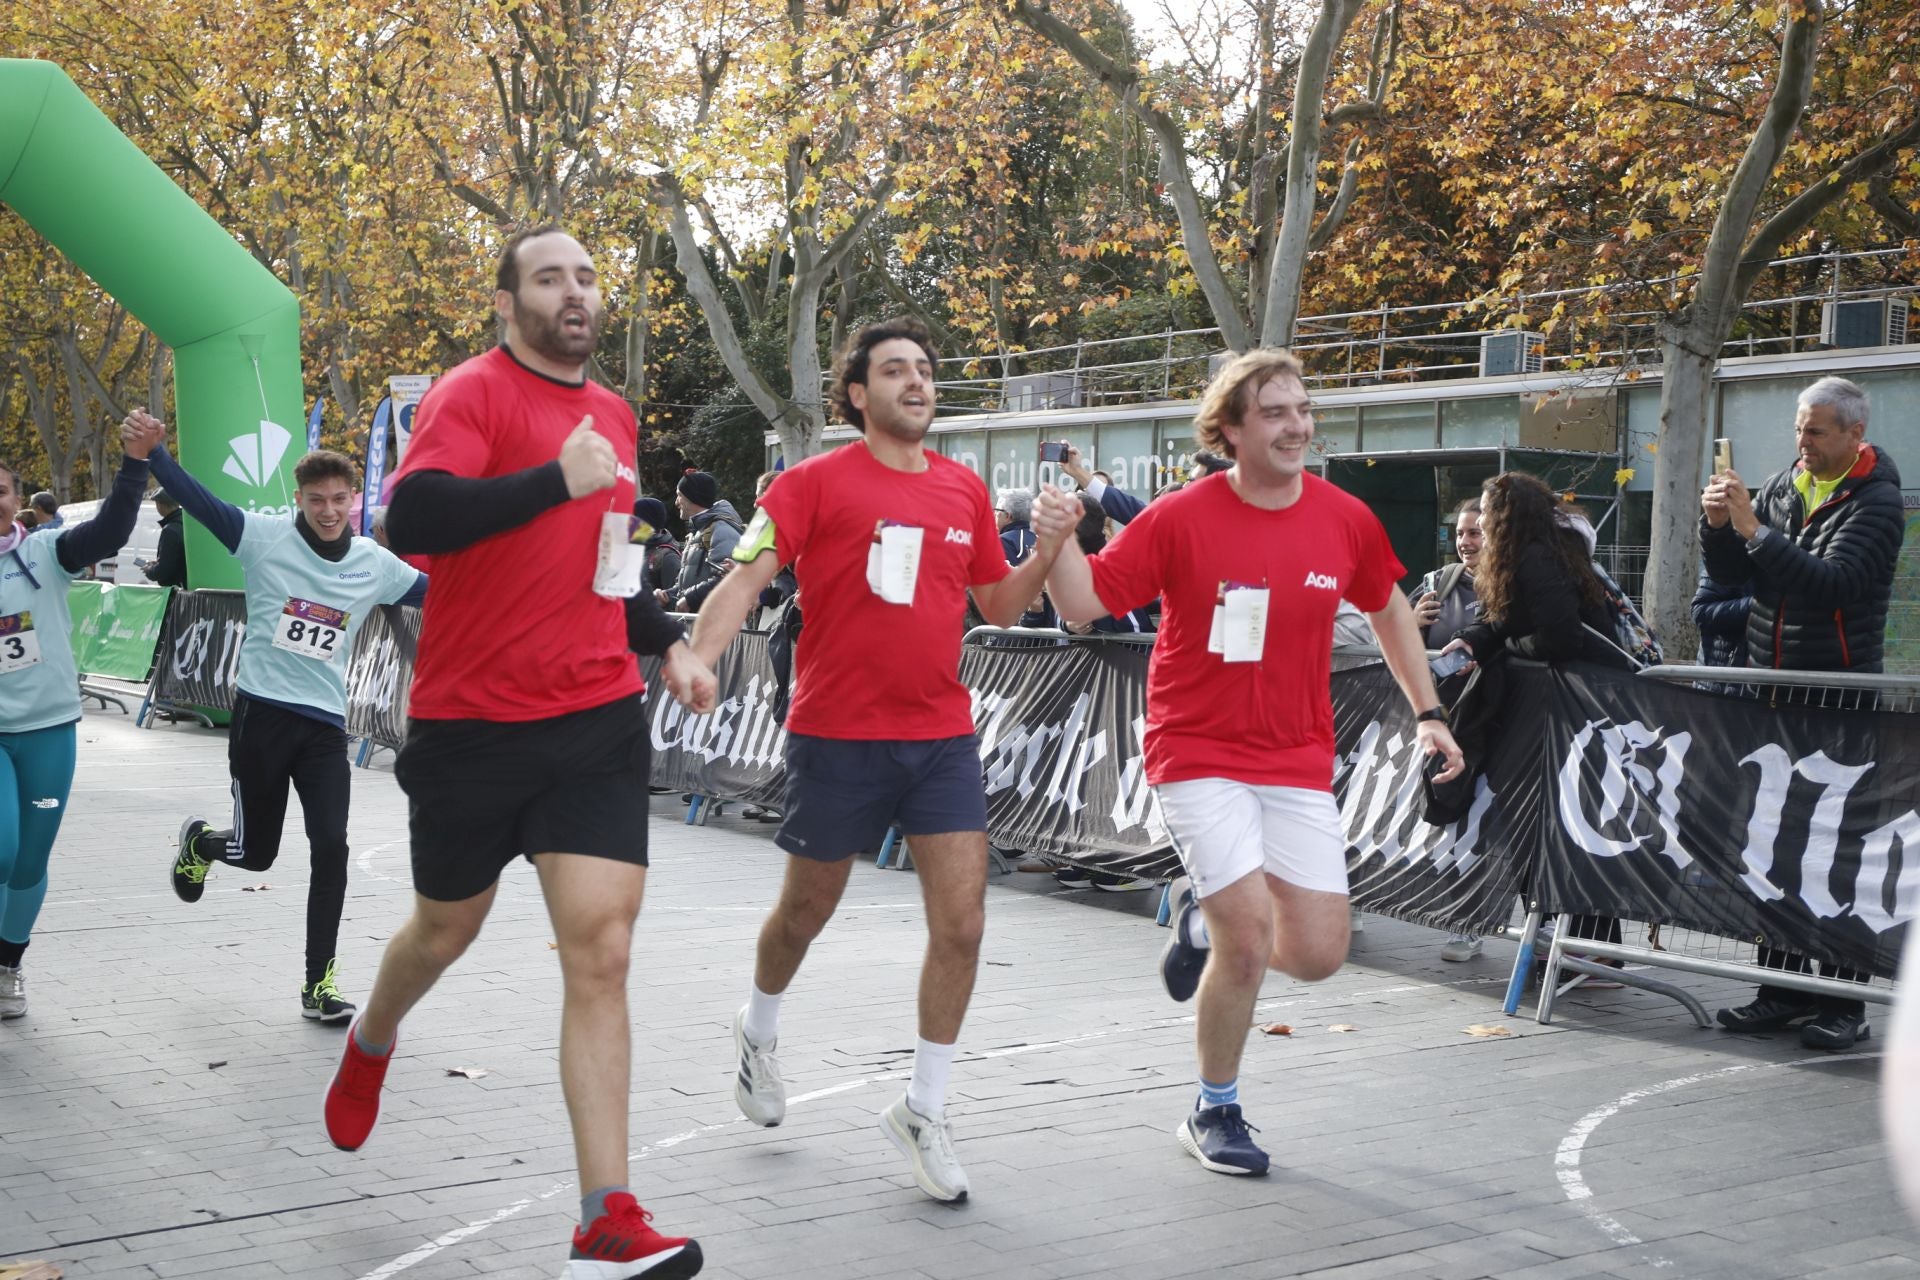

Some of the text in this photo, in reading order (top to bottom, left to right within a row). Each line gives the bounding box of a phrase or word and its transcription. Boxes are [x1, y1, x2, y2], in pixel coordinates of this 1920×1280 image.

[945, 526, 972, 547] AON
[339, 571, 372, 580] OneHealth
[1304, 571, 1337, 590] AON
[286, 620, 337, 651] 812
[0, 637, 25, 661] 3
